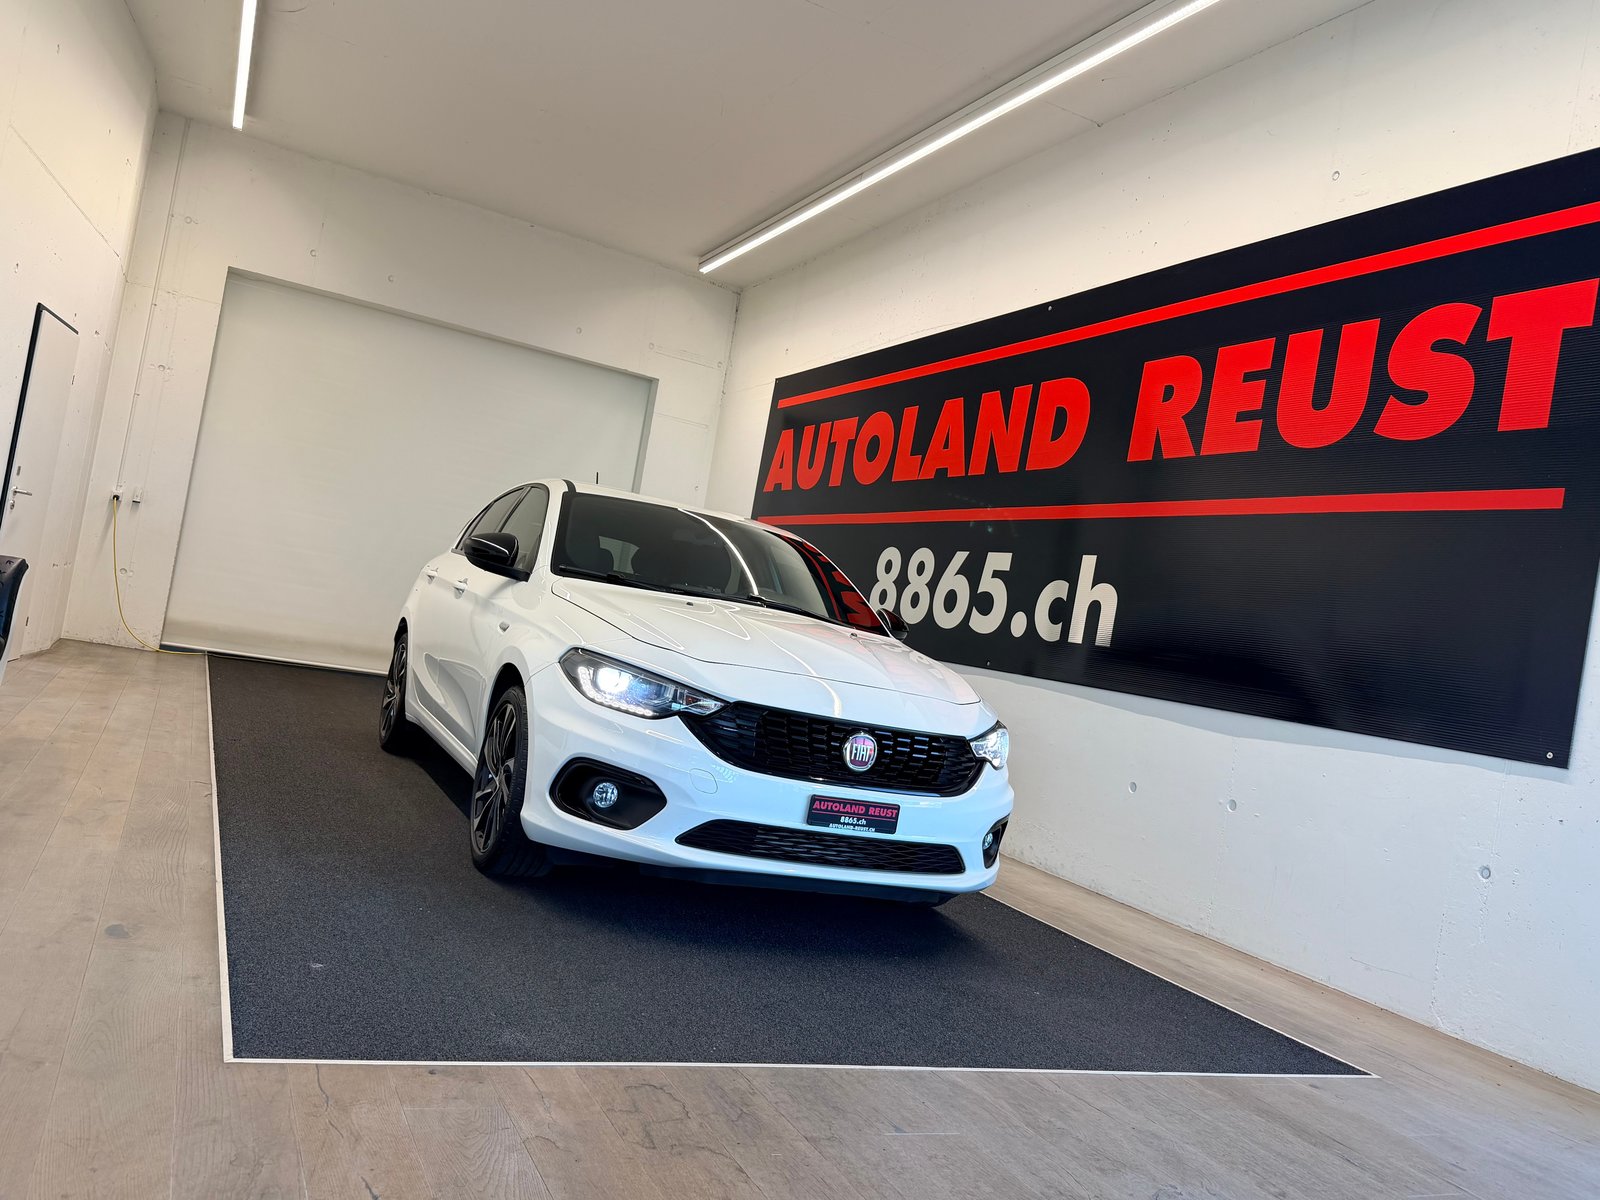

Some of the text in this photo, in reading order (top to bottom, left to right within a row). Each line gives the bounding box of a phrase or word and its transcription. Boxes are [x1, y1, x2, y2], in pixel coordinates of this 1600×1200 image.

[764, 278, 1600, 493] AUTOLAND REUST
[869, 546, 1119, 647] 8865.ch
[851, 744, 872, 761] FIAT
[813, 801, 898, 818] AUTOLAND REUST
[840, 816, 867, 825] 8865.ch
